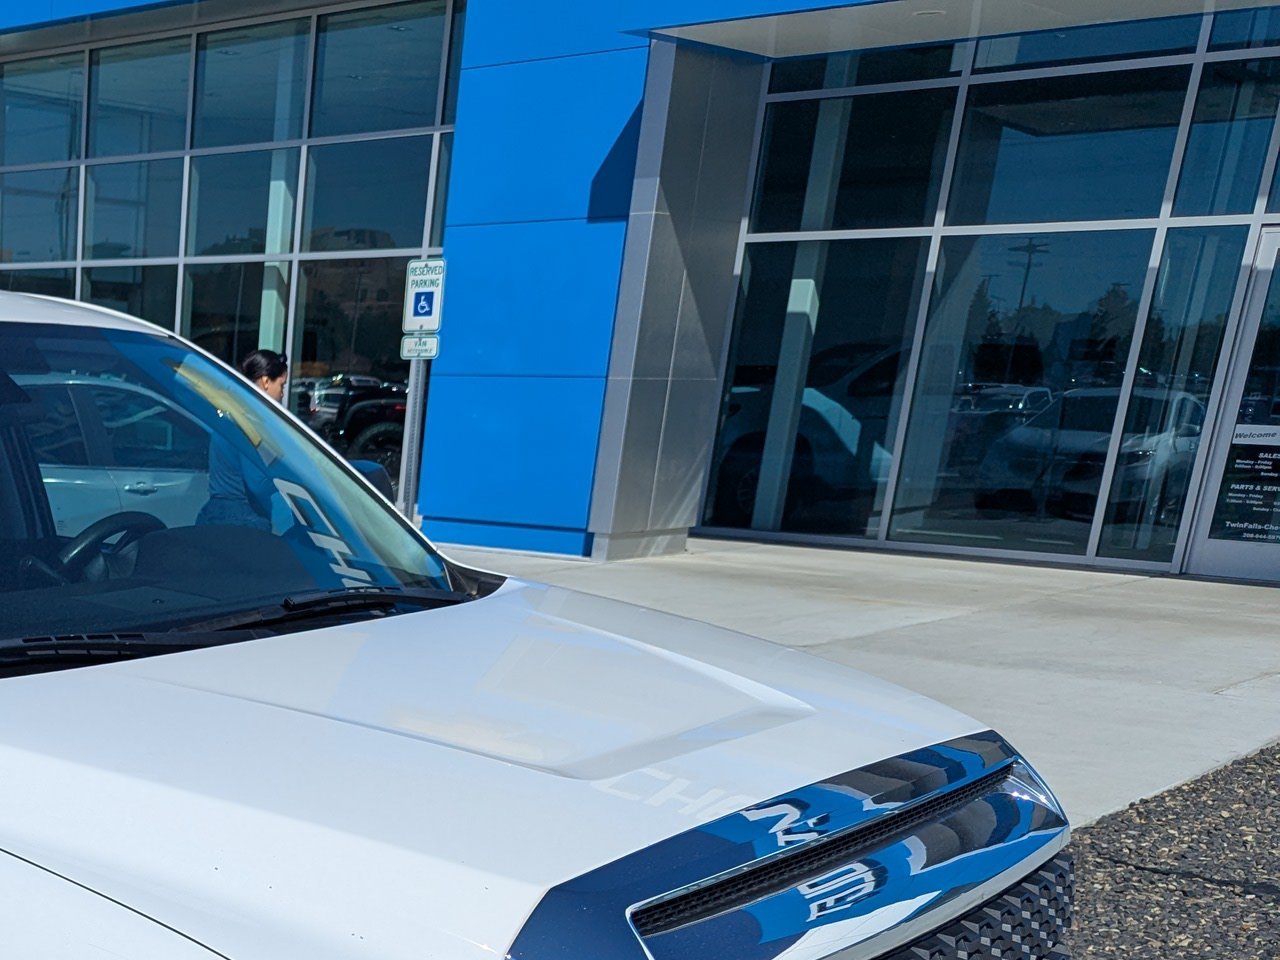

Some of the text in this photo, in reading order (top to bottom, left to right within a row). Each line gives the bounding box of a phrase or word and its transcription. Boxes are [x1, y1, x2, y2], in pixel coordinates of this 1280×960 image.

[410, 266, 443, 276] RESERVED
[410, 279, 440, 288] PARKING
[1234, 431, 1278, 440] Welcome
